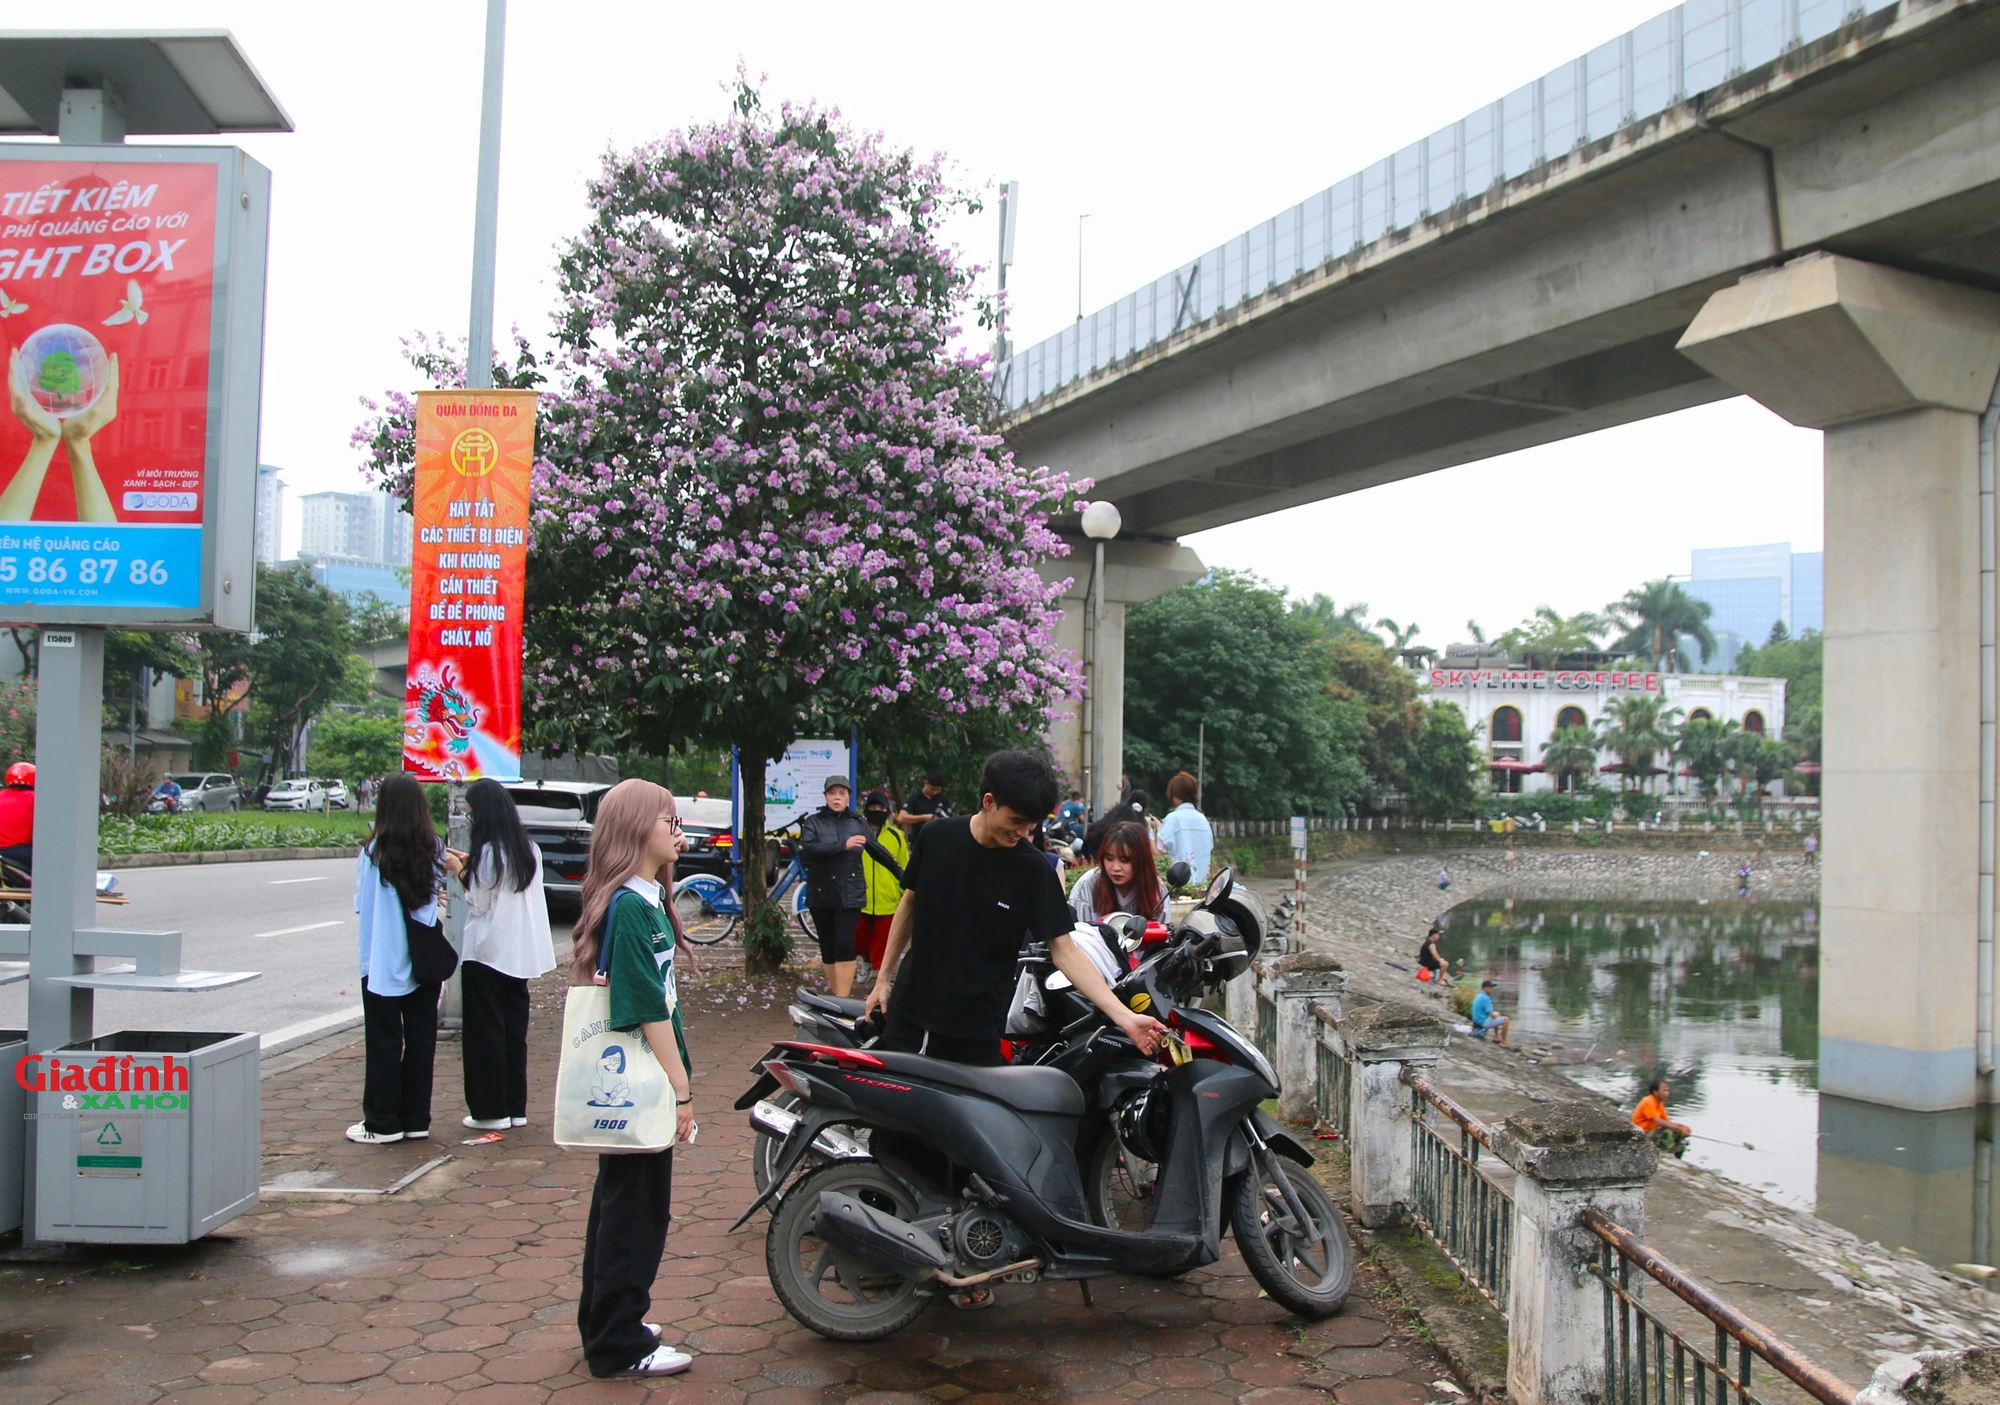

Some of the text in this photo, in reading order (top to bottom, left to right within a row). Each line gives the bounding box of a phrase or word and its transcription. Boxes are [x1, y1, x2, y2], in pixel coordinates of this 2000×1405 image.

[1, 180, 158, 217] TIẾT KIỆM
[2, 211, 189, 238] PHÍ QUẢNG CÁO VỚI
[81, 238, 187, 277] BOX
[503, 405, 518, 417] ĐA
[146, 469, 162, 478] MÔI
[164, 469, 199, 478] TRƯỜNG
[123, 479, 147, 487] XANH
[153, 480, 176, 489] SẠCH
[182, 480, 199, 489] ĐẸP
[145, 494, 190, 508] GODA
[450, 497, 495, 518] HÃY TẮT
[23, 535, 41, 552] HỆ
[44, 536, 90, 552] QUẢNG
[93, 537, 120, 551] CÁO
[420, 523, 523, 547] CÁC THIẾT BỊ ĐIỆN
[439, 550, 501, 569] KHI KHÔNG
[0, 557, 168, 585] 5 86 87 86
[5, 587, 98, 596] WWW.GODA-VN.COM
[466, 574, 498, 595] THIẾT
[465, 601, 505, 621] PHÒNG
[47, 635, 72, 644] E15009
[441, 625, 493, 648] CHÁY, NỔ
[1430, 669, 1660, 692] SKYLINE COFFEE
[1097, 1037, 1122, 1048] HONDA
[844, 1074, 911, 1092] VISION
[593, 1119, 628, 1130] 1908
